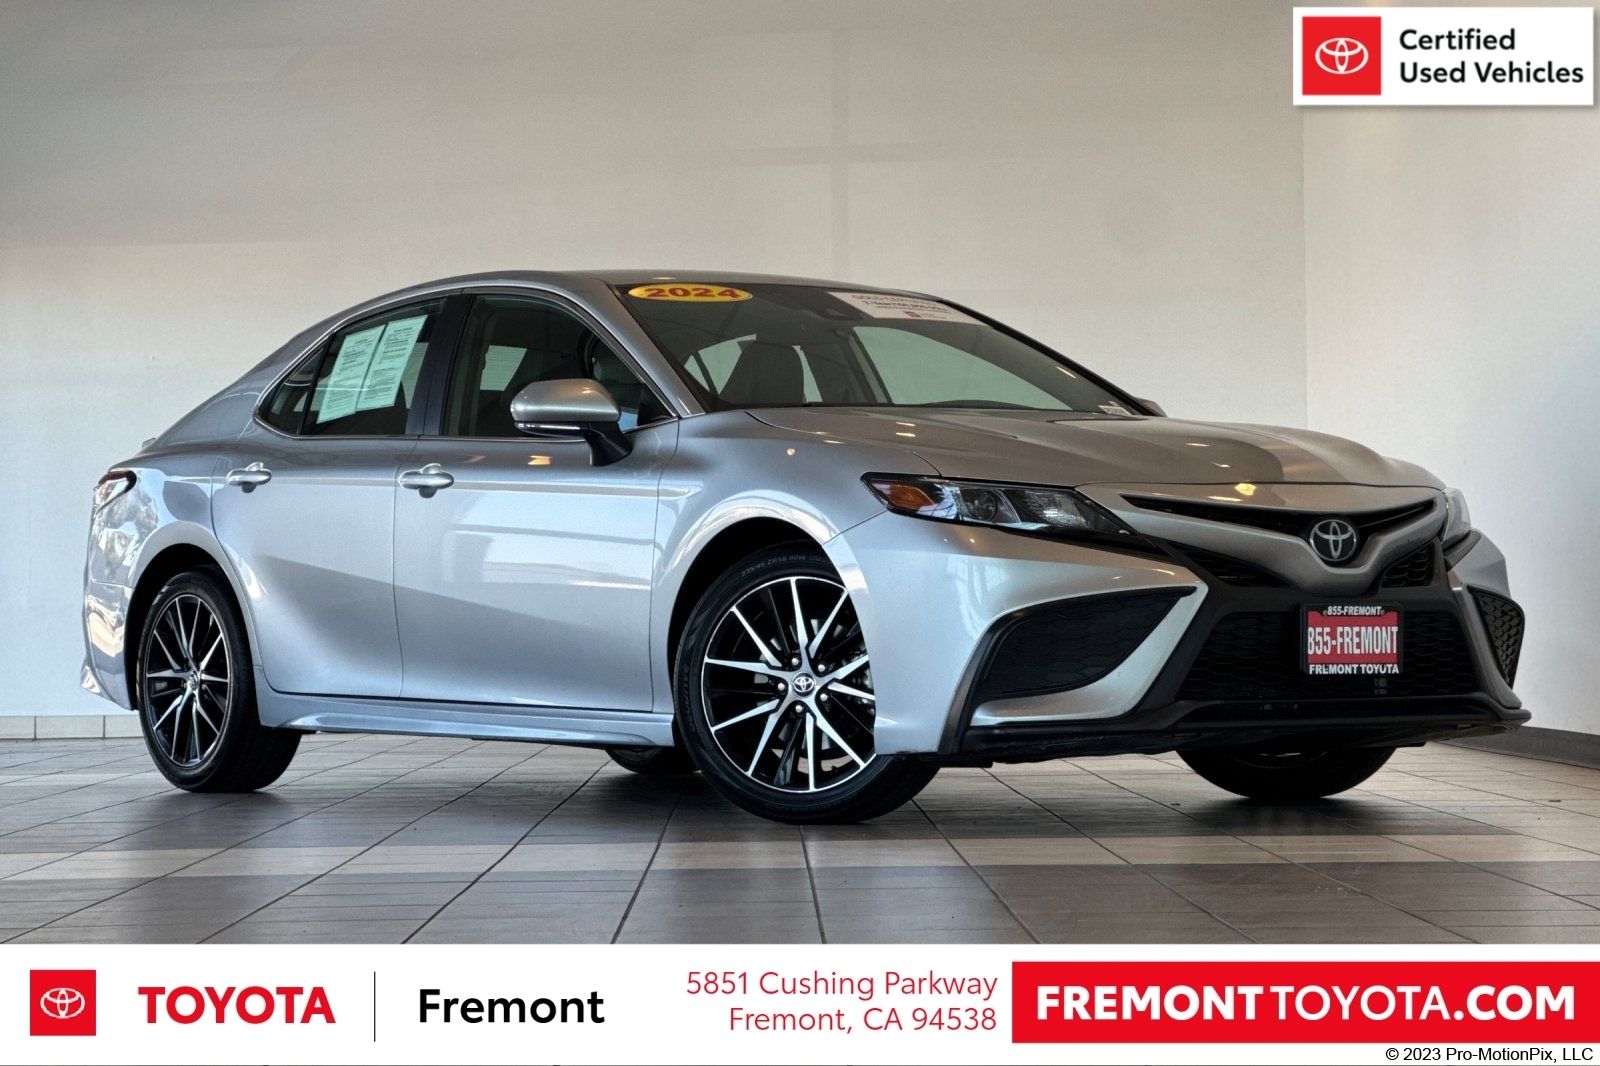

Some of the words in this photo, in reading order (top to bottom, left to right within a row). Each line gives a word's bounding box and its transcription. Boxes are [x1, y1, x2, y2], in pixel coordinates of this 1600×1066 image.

[643, 287, 741, 298] 2024
[1327, 606, 1382, 616] 855-FREMONT
[1307, 626, 1399, 655] 855-FREMONT
[1309, 664, 1358, 675] FREMONT
[1360, 664, 1400, 674] TOYOTA
